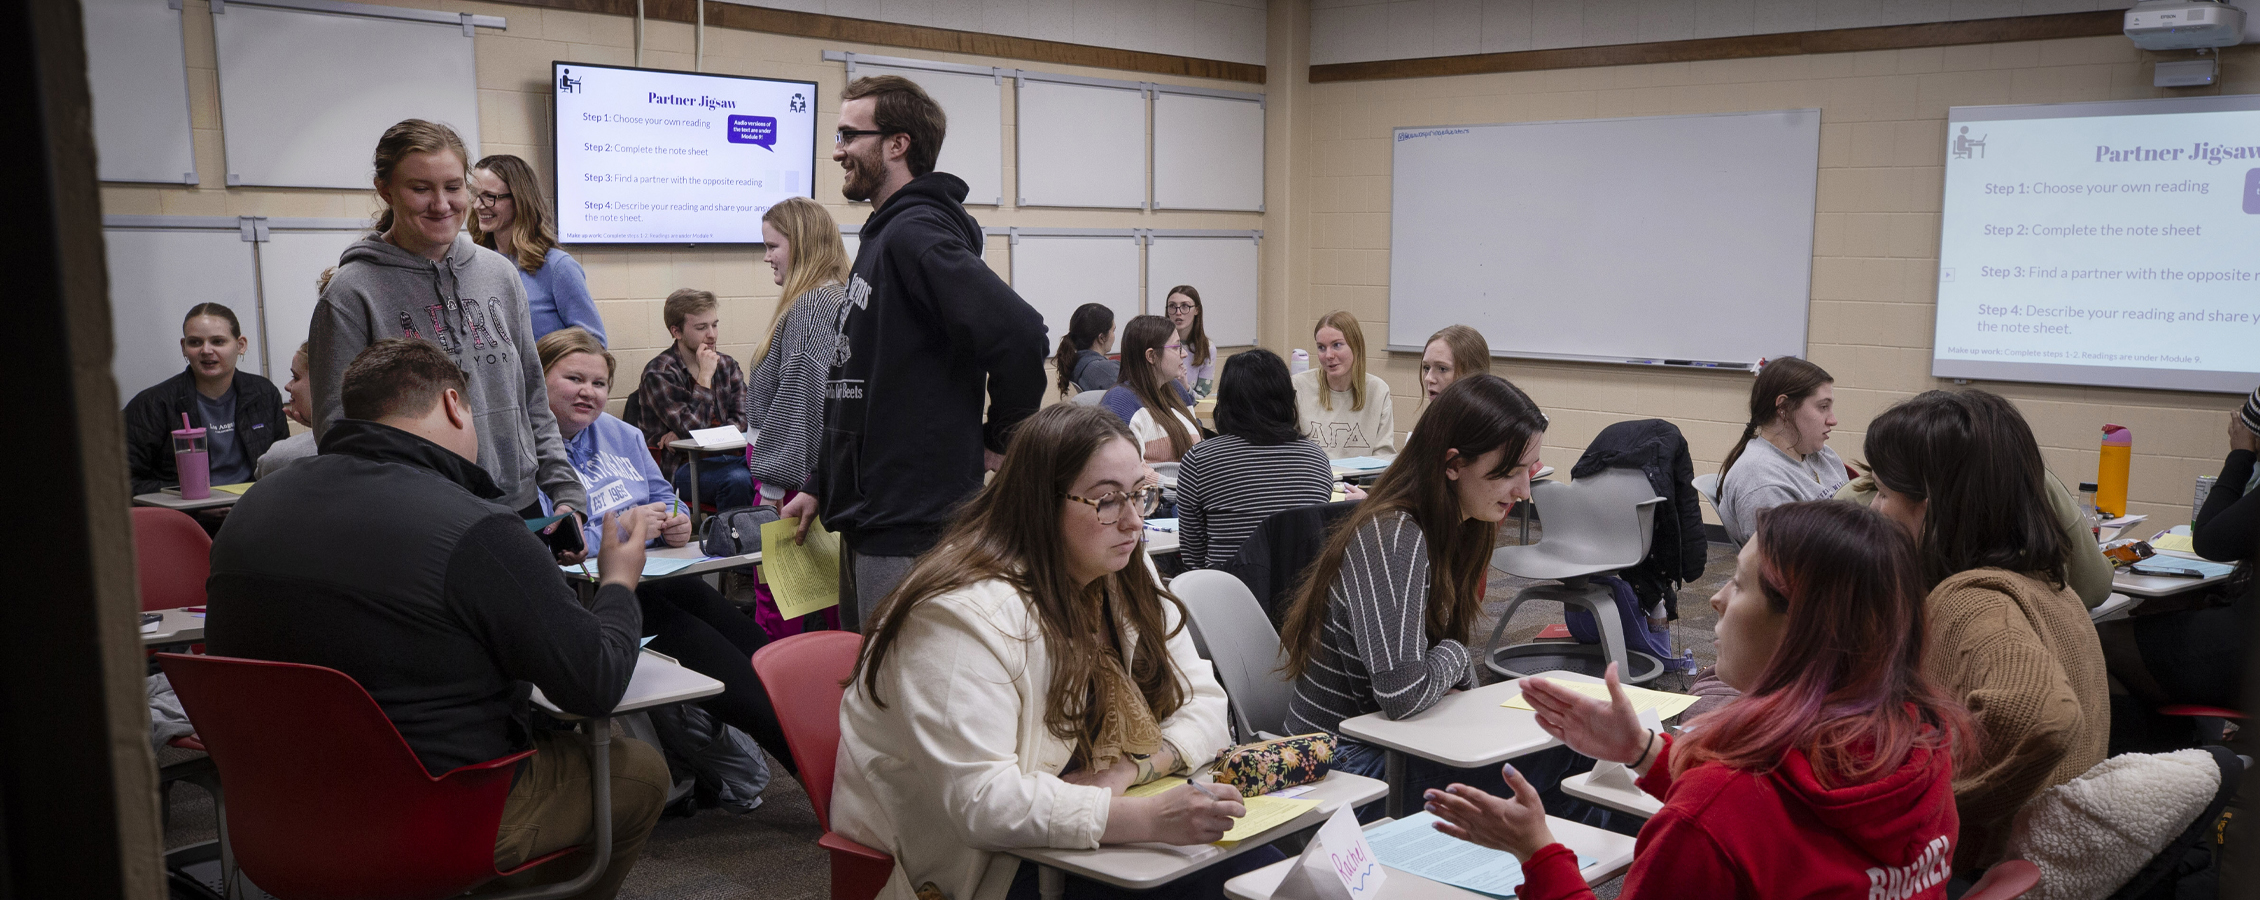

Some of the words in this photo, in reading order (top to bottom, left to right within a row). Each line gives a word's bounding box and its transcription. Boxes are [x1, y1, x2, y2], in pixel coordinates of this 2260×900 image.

[648, 92, 696, 106] Partner
[699, 95, 736, 111] Jigsaw
[583, 112, 602, 123] Step
[604, 113, 612, 122] 1:
[613, 114, 643, 124] Choose
[645, 118, 662, 126] your
[682, 118, 711, 129] reading
[584, 142, 603, 153] Step
[605, 143, 613, 152] 2:
[614, 143, 653, 155] Complete
[654, 146, 668, 154] the
[669, 147, 687, 155] note
[688, 147, 709, 156] sheet
[2095, 145, 2184, 162] Partner
[584, 172, 604, 183] Step
[605, 173, 613, 182] 3:
[614, 174, 632, 183] Find
[640, 175, 669, 185] partner
[670, 176, 688, 184] with
[689, 176, 702, 185] the
[702, 177, 735, 187] opposite
[735, 177, 763, 188] reading
[1985, 182, 2015, 196] Step
[2019, 182, 2029, 194] 1:
[2033, 182, 2083, 194] Choose
[2086, 184, 2118, 196] your
[2121, 184, 2151, 193] own
[2155, 180, 2209, 195] reading
[584, 200, 604, 211] Step
[604, 201, 613, 210] 4:
[614, 201, 649, 211] Describe
[651, 204, 669, 212] your
[670, 202, 699, 213] reading
[700, 203, 714, 211] and
[714, 203, 735, 212] share
[584, 213, 599, 222] the
[600, 213, 618, 222] note
[619, 213, 644, 222] sheet.
[1984, 224, 2014, 237] Step
[2017, 224, 2028, 235] 2:
[2032, 223, 2097, 238] Complete
[2101, 224, 2123, 236] the
[2127, 225, 2158, 236] note
[2162, 224, 2201, 236] sheet
[1981, 266, 2010, 279] Step
[2013, 266, 2025, 278] 3:
[2029, 266, 2058, 279] Find
[2060, 270, 2068, 279] a
[2071, 268, 2122, 281] partner
[2126, 268, 2157, 280] with
[2161, 268, 2184, 280] the
[2187, 269, 2251, 283] opposite
[1978, 304, 2008, 317] Step
[2010, 304, 2022, 316] 4:
[2026, 304, 2084, 318] Describe
[2088, 309, 2119, 320] your
[2122, 308, 2175, 323] reading
[2178, 309, 2205, 321] and
[2208, 309, 2249, 322] share
[1977, 320, 1998, 332] the
[2001, 322, 2031, 333] note
[2033, 322, 2072, 334] sheet.
[473, 352, 515, 367] YOR
[1947, 346, 1969, 354] Make
[1970, 348, 1980, 356] up
[2004, 348, 2041, 357] Complete
[2042, 350, 2064, 359] steps
[2065, 350, 2080, 359] 1-2.
[2081, 351, 2118, 361] Readings
[2133, 353, 2159, 361] under
[2160, 354, 2193, 363] Module
[2194, 355, 2202, 364] 9.
[842, 382, 863, 399] Beets
[593, 492, 606, 511] EST
[1332, 839, 1368, 885] Rachel
